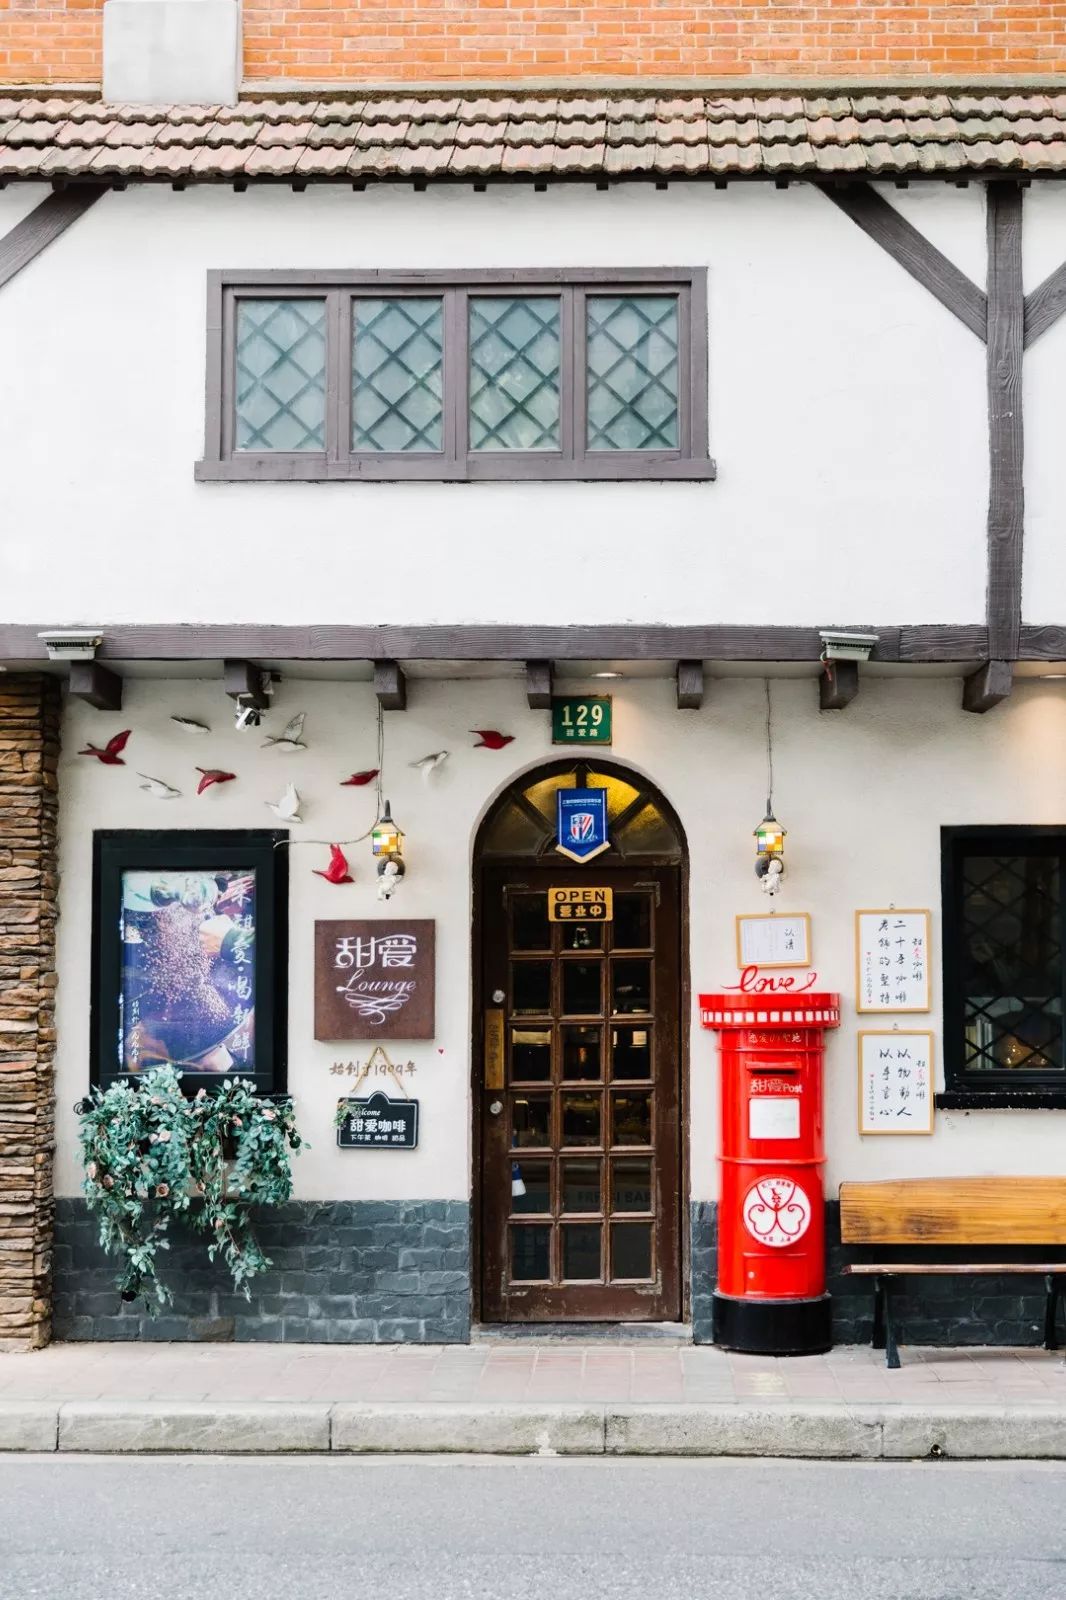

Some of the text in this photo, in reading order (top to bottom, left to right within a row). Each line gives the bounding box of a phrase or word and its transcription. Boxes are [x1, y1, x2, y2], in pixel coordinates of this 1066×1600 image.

[562, 704, 603, 726] 129
[555, 890, 605, 902] OPEN
[560, 904, 602, 918] 营业中
[334, 934, 417, 969] 甜爱
[336, 968, 416, 1004] Lounge
[720, 965, 817, 993] love
[350, 1119, 406, 1133] 甜爱咖啡
